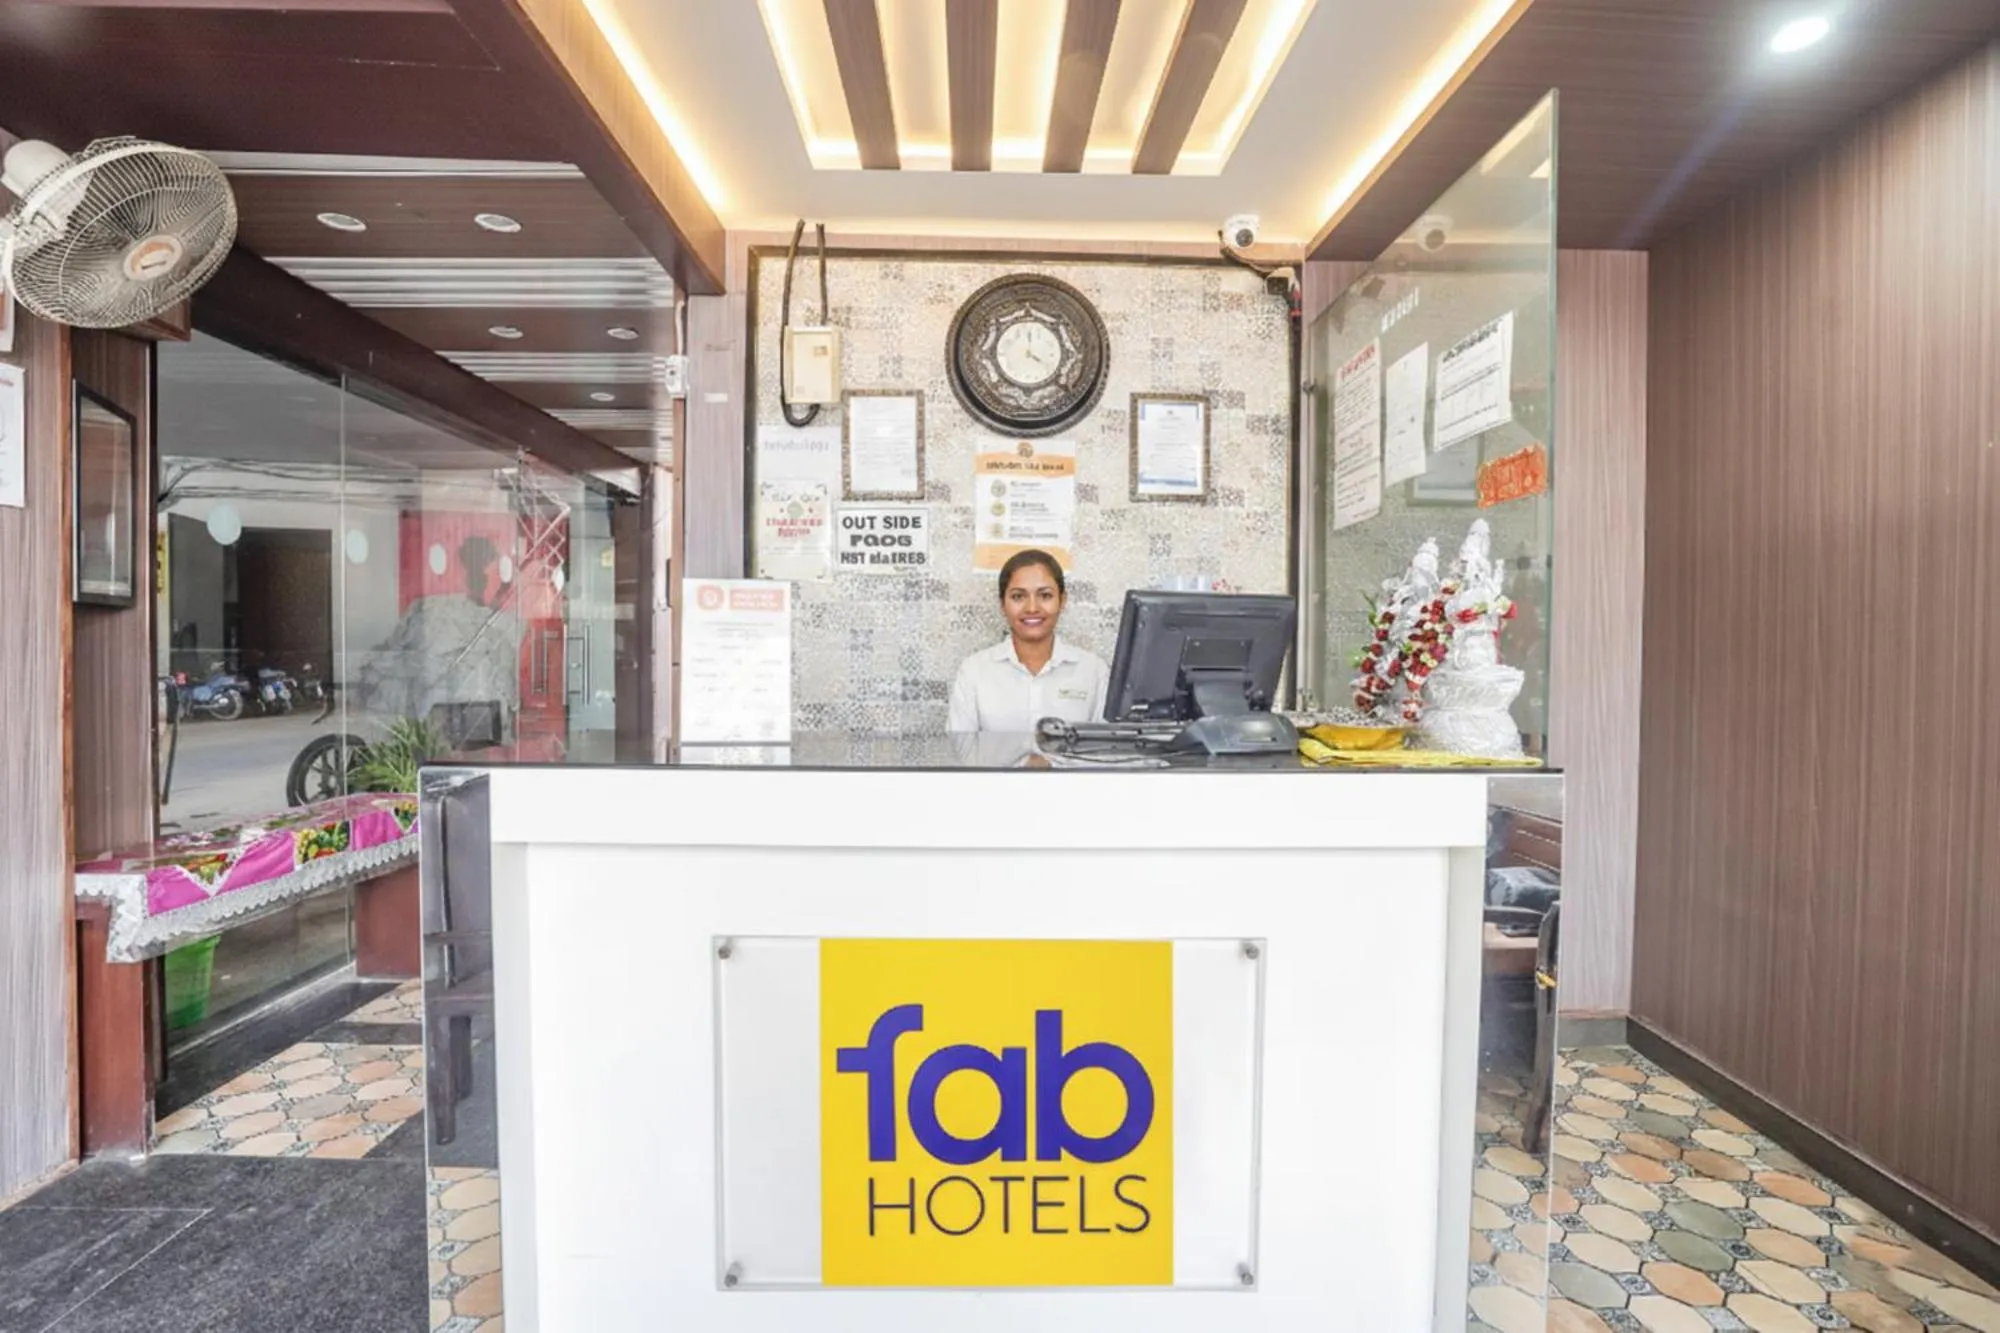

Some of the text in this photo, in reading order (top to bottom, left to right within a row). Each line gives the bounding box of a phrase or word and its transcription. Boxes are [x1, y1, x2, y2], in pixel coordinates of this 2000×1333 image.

[842, 515, 922, 530] OUT SIDE
[837, 1004, 1154, 1165] fab
[868, 1174, 1151, 1236] HOTELS
